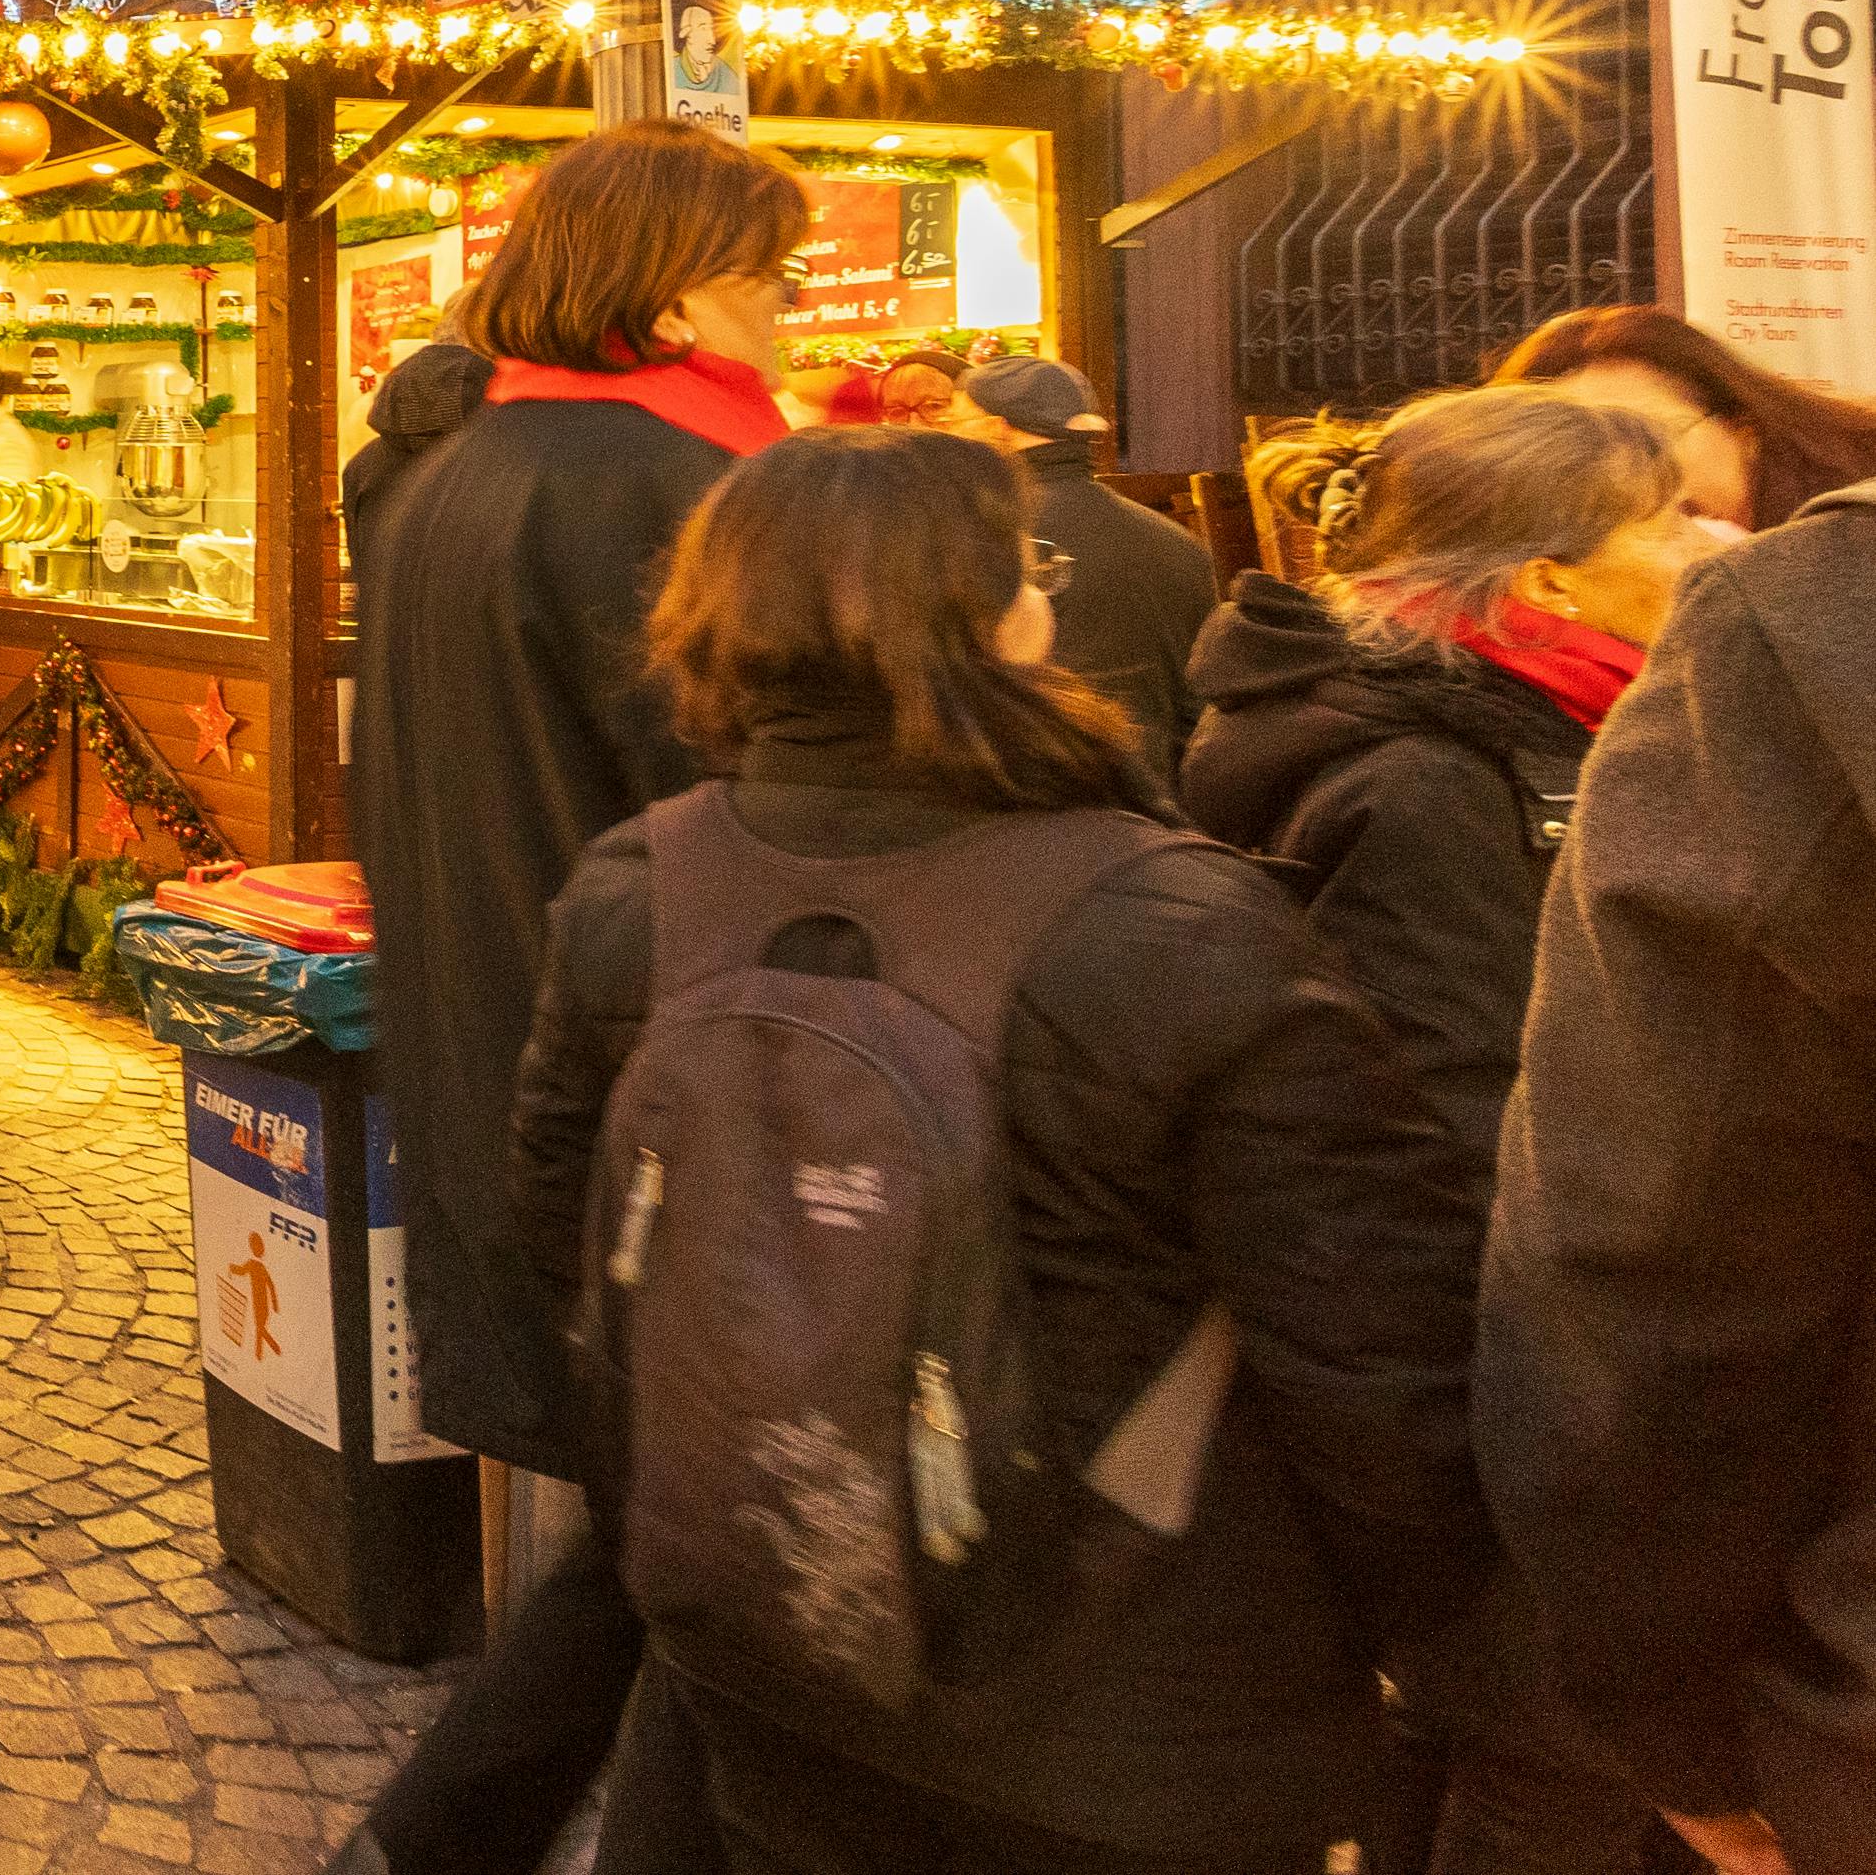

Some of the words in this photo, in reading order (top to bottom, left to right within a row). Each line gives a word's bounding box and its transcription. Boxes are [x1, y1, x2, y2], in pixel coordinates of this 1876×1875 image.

[676, 99, 742, 132] Goethe
[1724, 250, 1767, 269] Room
[885, 297, 900, 317] €
[1727, 322, 1756, 342] City
[195, 1081, 256, 1132] EIMER
[257, 1110, 309, 1150] FÜR
